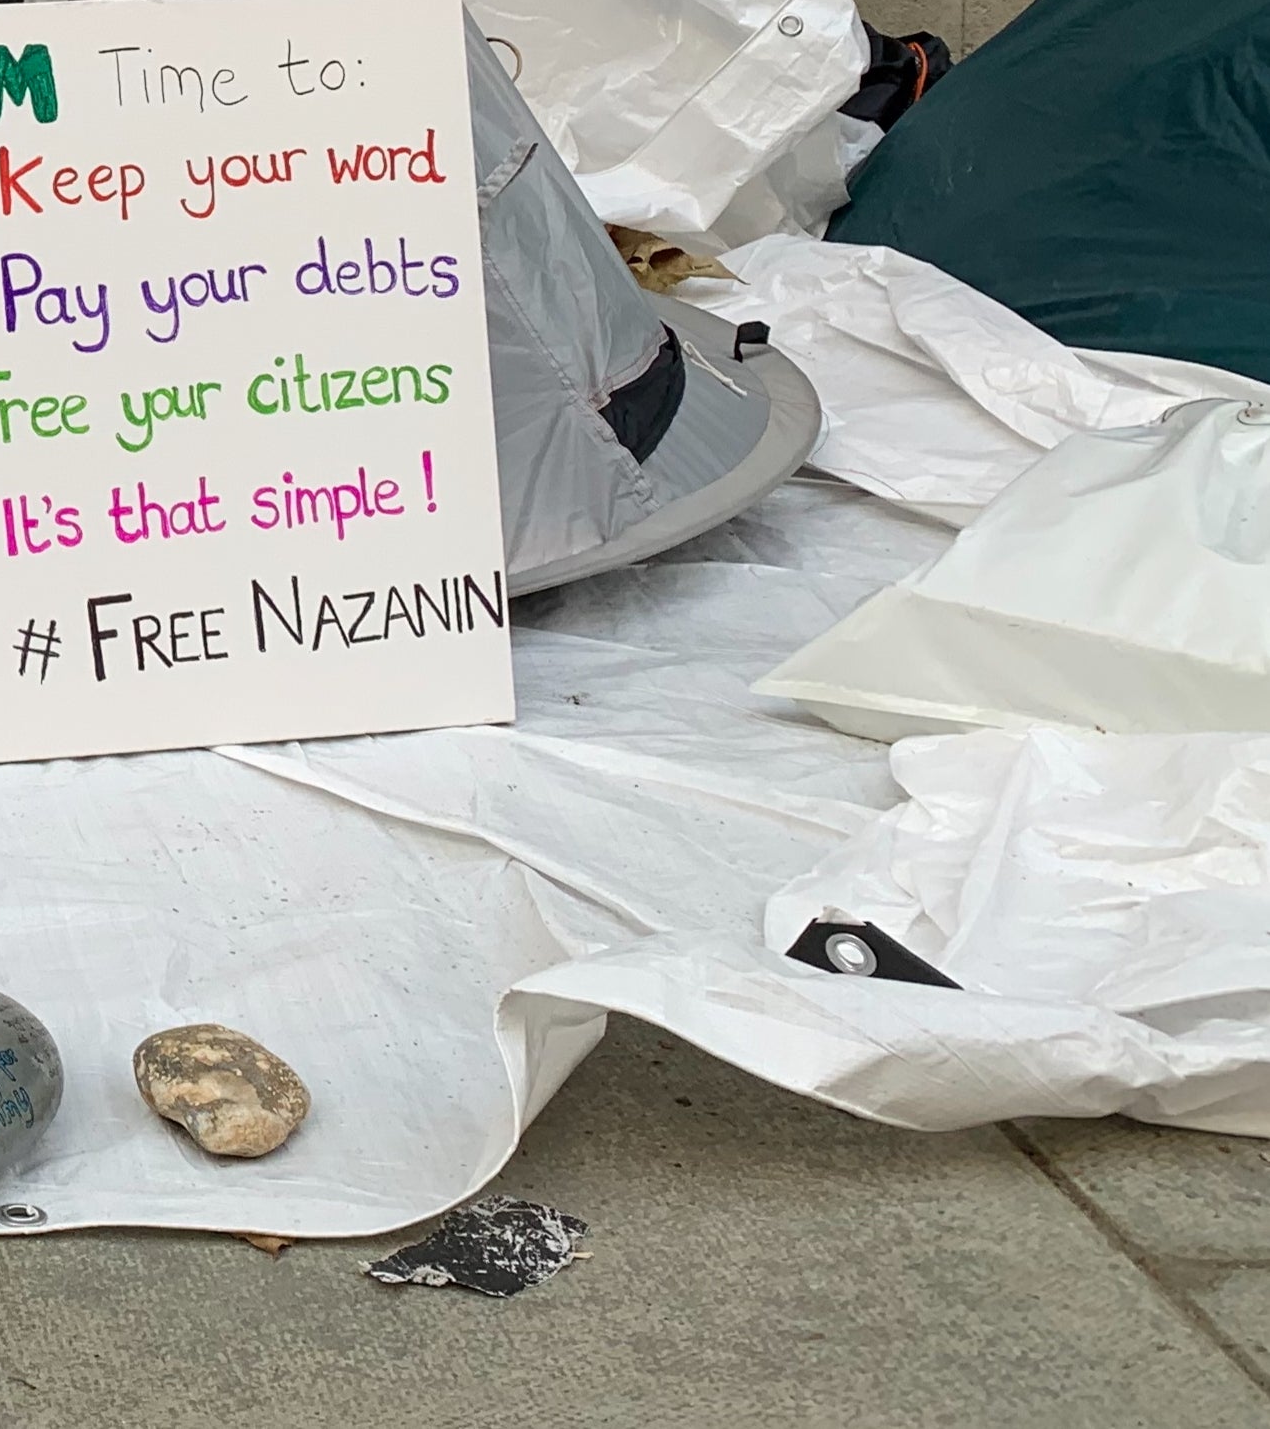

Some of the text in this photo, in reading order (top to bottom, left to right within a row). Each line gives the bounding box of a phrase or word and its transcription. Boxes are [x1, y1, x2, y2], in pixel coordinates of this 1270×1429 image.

[99, 47, 248, 112] Time
[278, 40, 362, 95] to:
[181, 149, 307, 218] your
[327, 129, 446, 184] word
[1, 236, 459, 353] Pay your debts
[116, 383, 221, 452] your
[247, 354, 452, 414] citizens
[3, 495, 83, 556] It's
[108, 477, 226, 543] that
[251, 467, 404, 540] simple
[87, 593, 228, 681] FREE
[251, 570, 506, 653] NAZANIN
